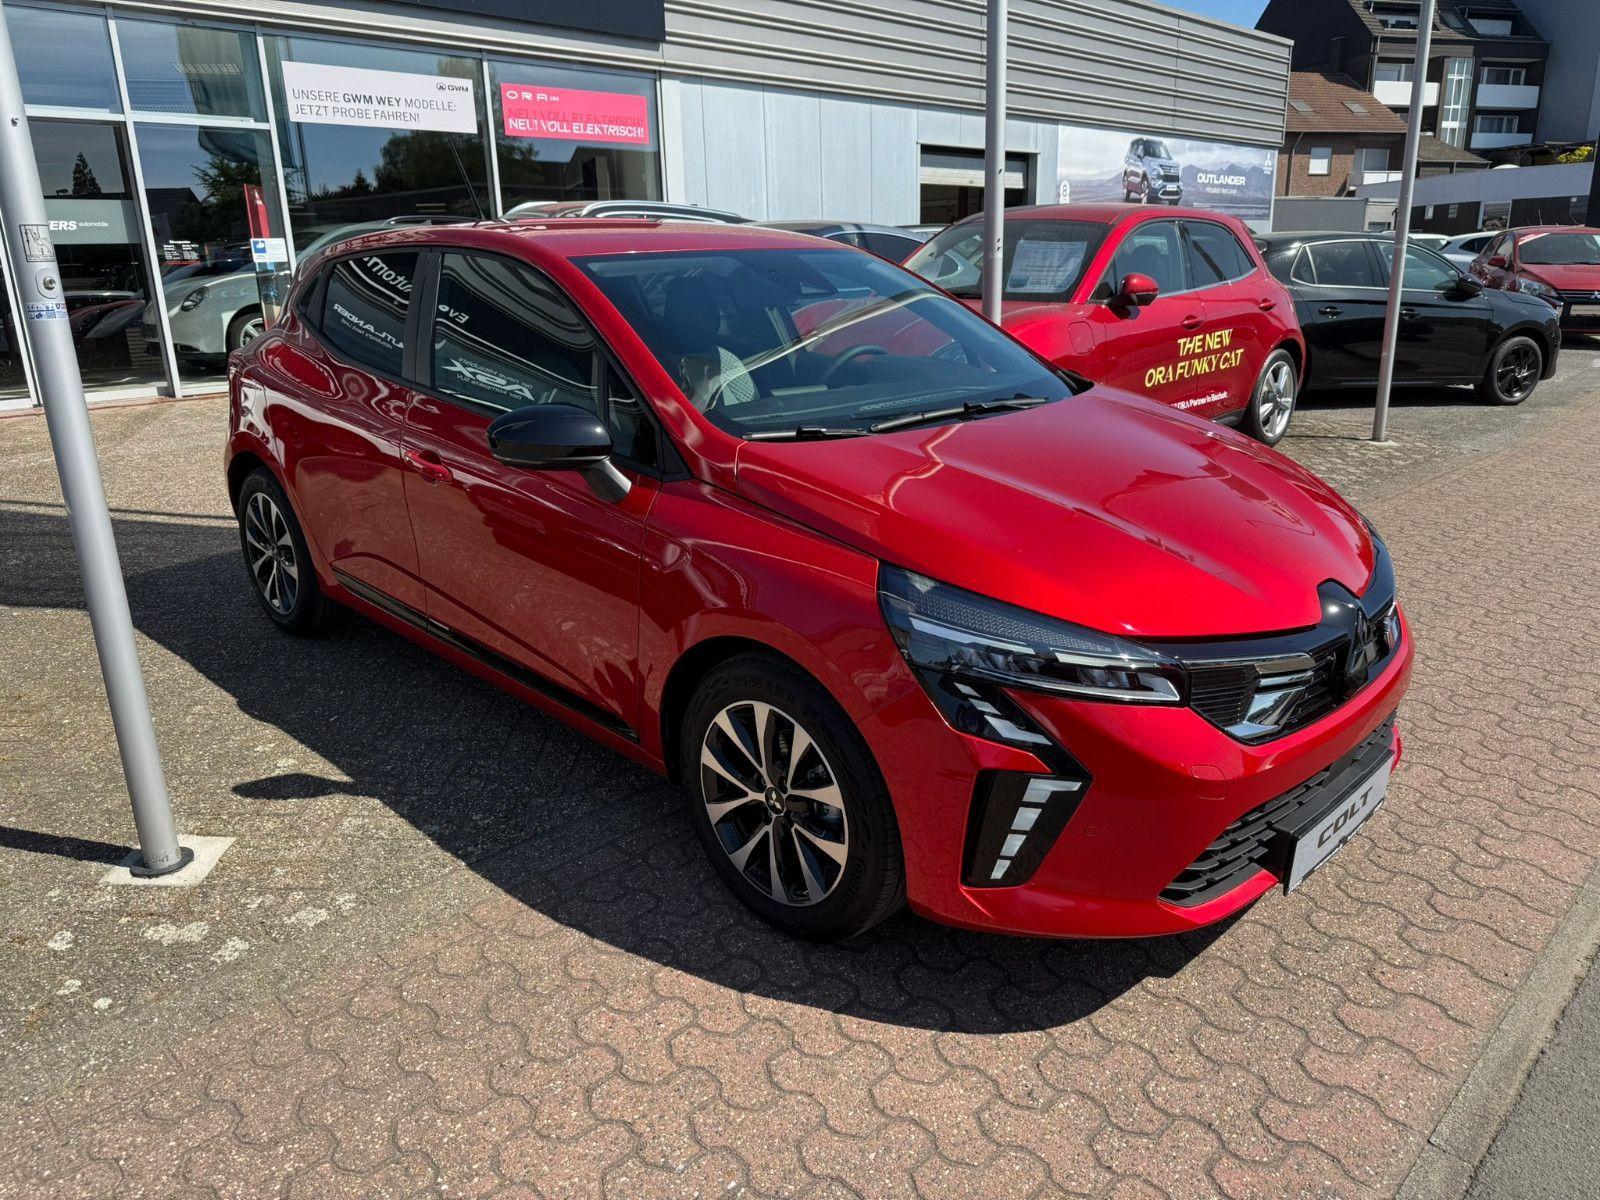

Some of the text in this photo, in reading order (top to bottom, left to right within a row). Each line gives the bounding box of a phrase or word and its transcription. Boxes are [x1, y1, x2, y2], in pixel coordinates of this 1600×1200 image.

[447, 84, 469, 93] GWM
[292, 88, 457, 112] UNSERE GWM WEY MODELLE:
[294, 104, 420, 123] JETZT PROBE FAHREN!
[572, 122, 645, 138] ELEKTRISCH!
[1197, 173, 1245, 186] OUTLANDER
[1177, 328, 1234, 357] THE NEW
[1144, 348, 1245, 388] ORA FUNKY CAT
[1318, 786, 1373, 848] COLT
